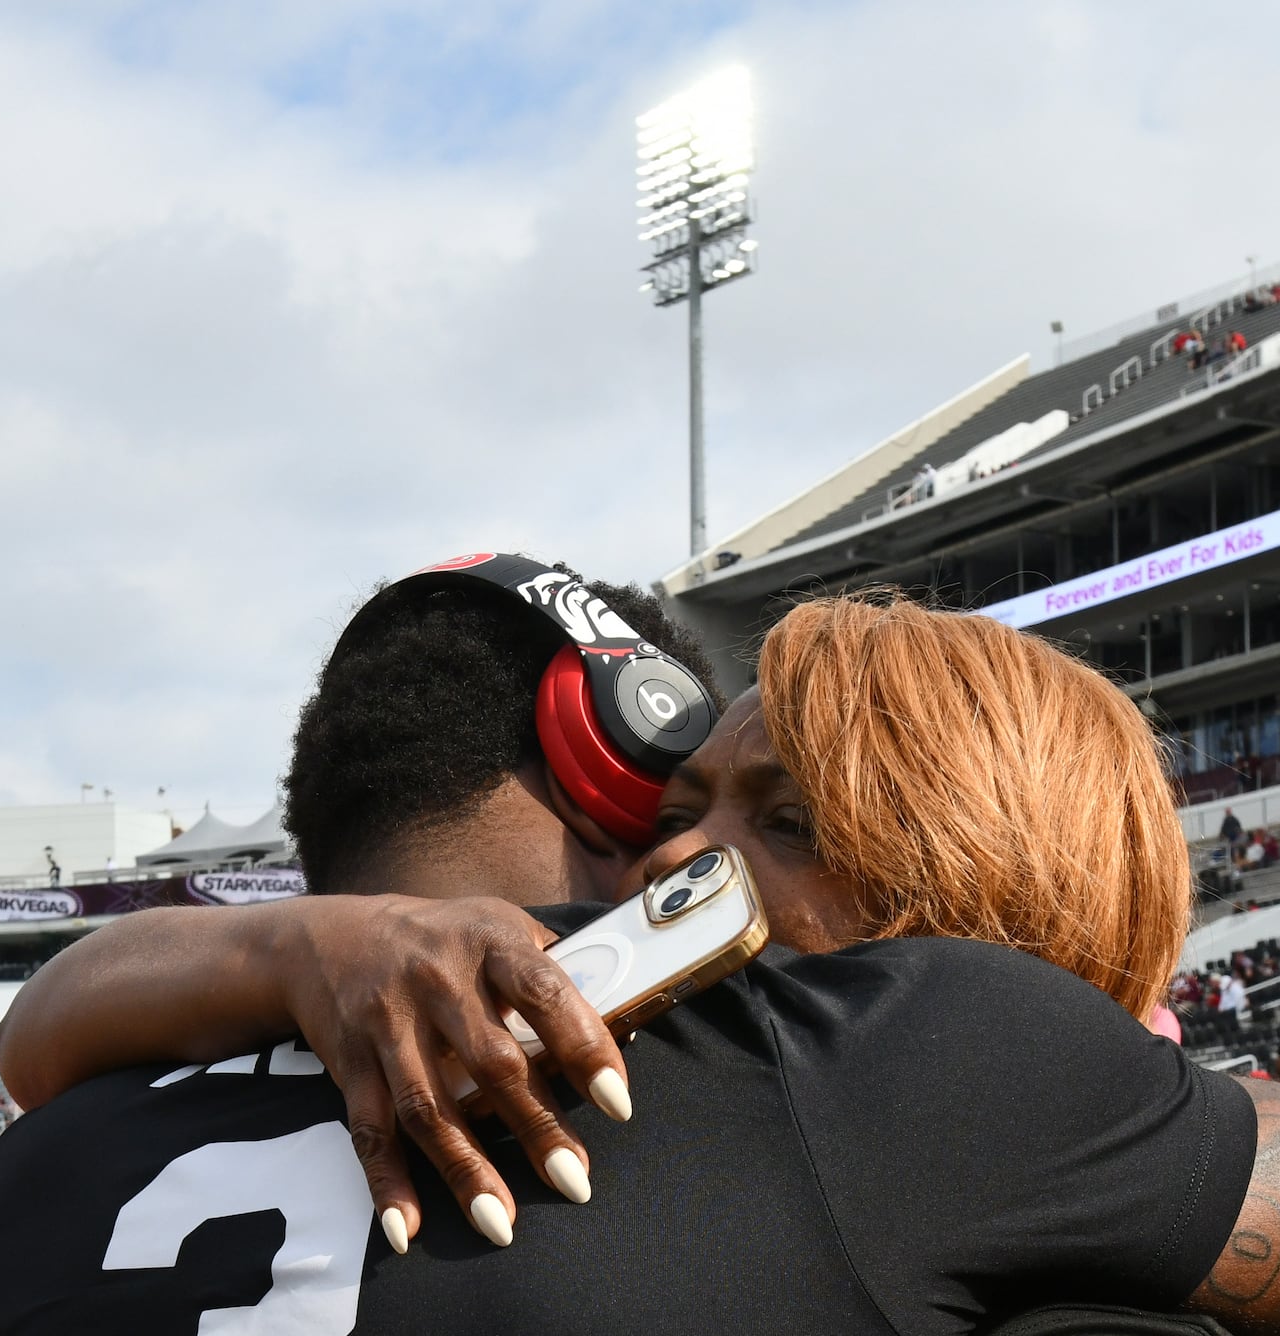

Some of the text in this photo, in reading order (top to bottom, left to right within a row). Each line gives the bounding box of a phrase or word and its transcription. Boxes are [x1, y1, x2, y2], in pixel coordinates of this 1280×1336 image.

[1045, 527, 1264, 613] Forever and Ever For Kids
[203, 876, 306, 893] STARKVEGAS
